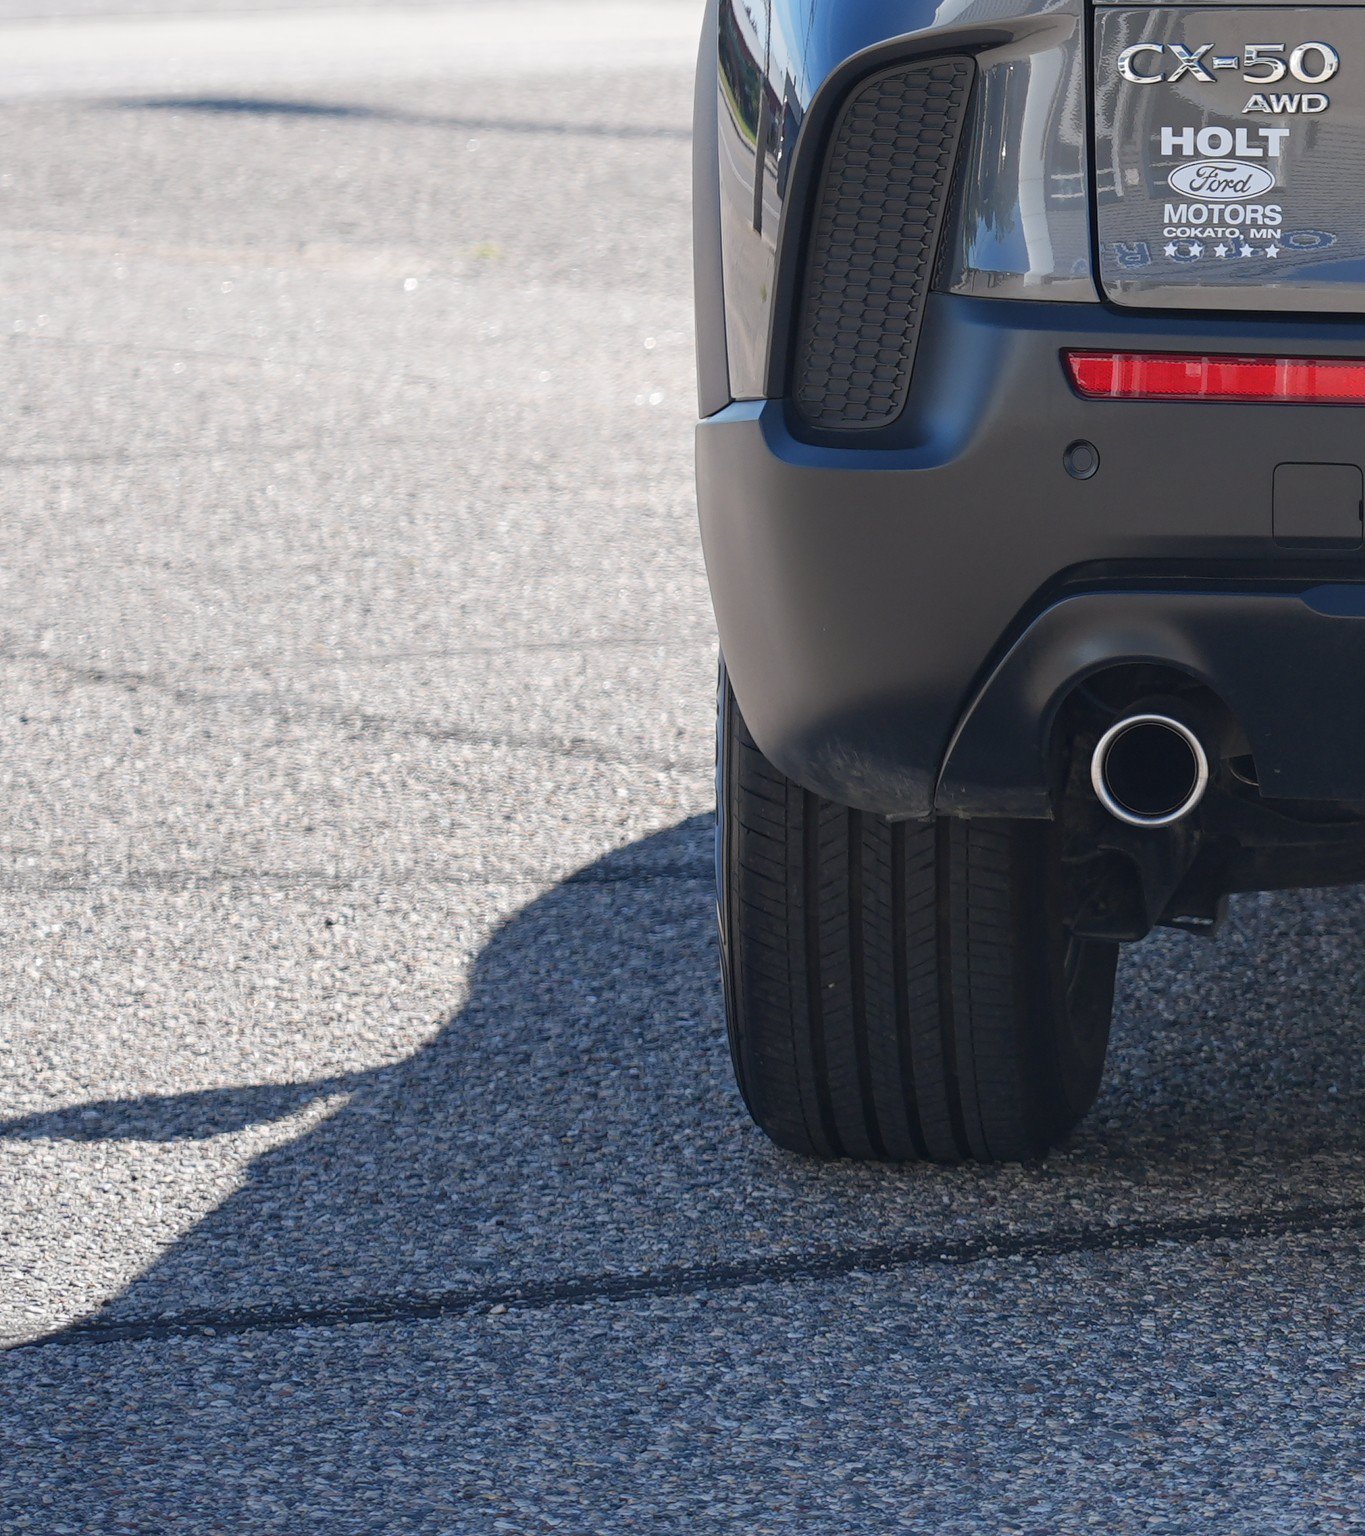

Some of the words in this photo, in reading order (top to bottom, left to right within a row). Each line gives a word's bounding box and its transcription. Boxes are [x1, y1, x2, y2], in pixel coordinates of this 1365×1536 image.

[1117, 41, 1340, 84] CX-50
[1242, 93, 1330, 114] AWD
[1160, 127, 1290, 156] HOLT
[1189, 166, 1252, 194] Ford
[1163, 204, 1282, 226] MOTORS
[1163, 228, 1244, 240] COKATO,
[1250, 228, 1281, 239] MN
